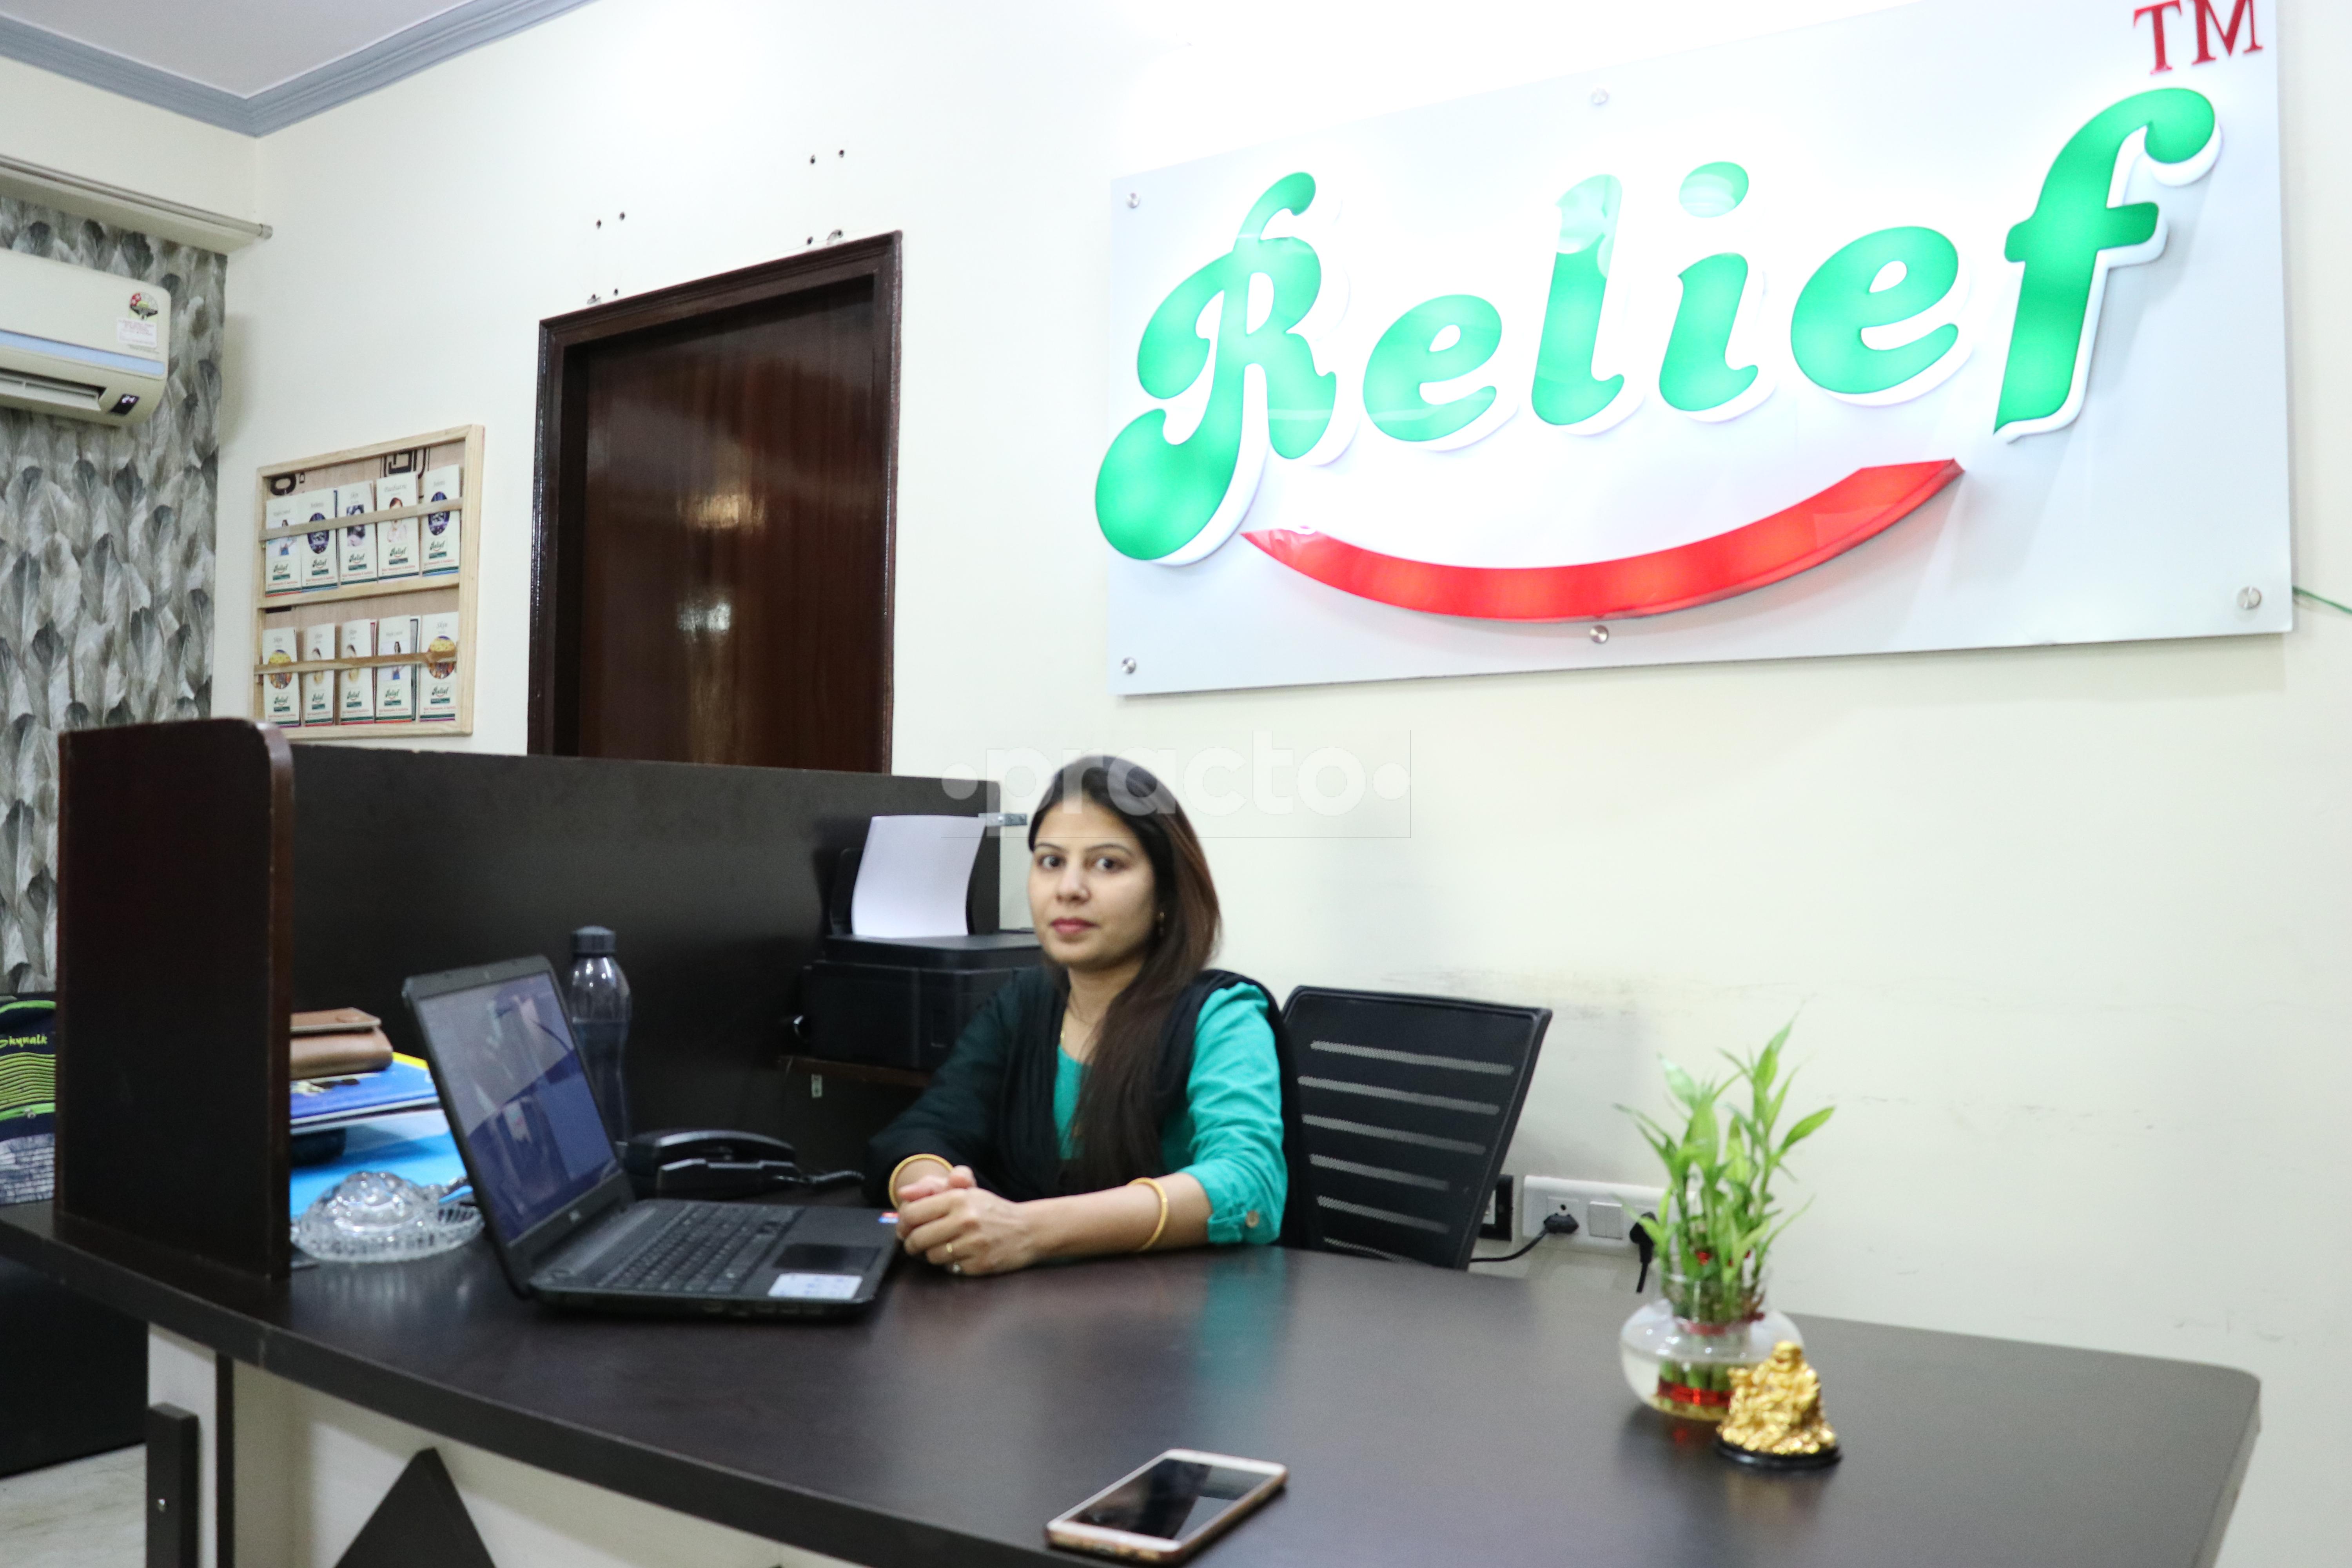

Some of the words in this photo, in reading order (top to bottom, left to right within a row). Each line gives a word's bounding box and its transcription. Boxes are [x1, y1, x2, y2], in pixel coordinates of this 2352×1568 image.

[2132, 0, 2264, 75] TM
[1096, 87, 2217, 561] Relief
[430, 540, 446, 550] Relief
[432, 685, 449, 695] Relief
